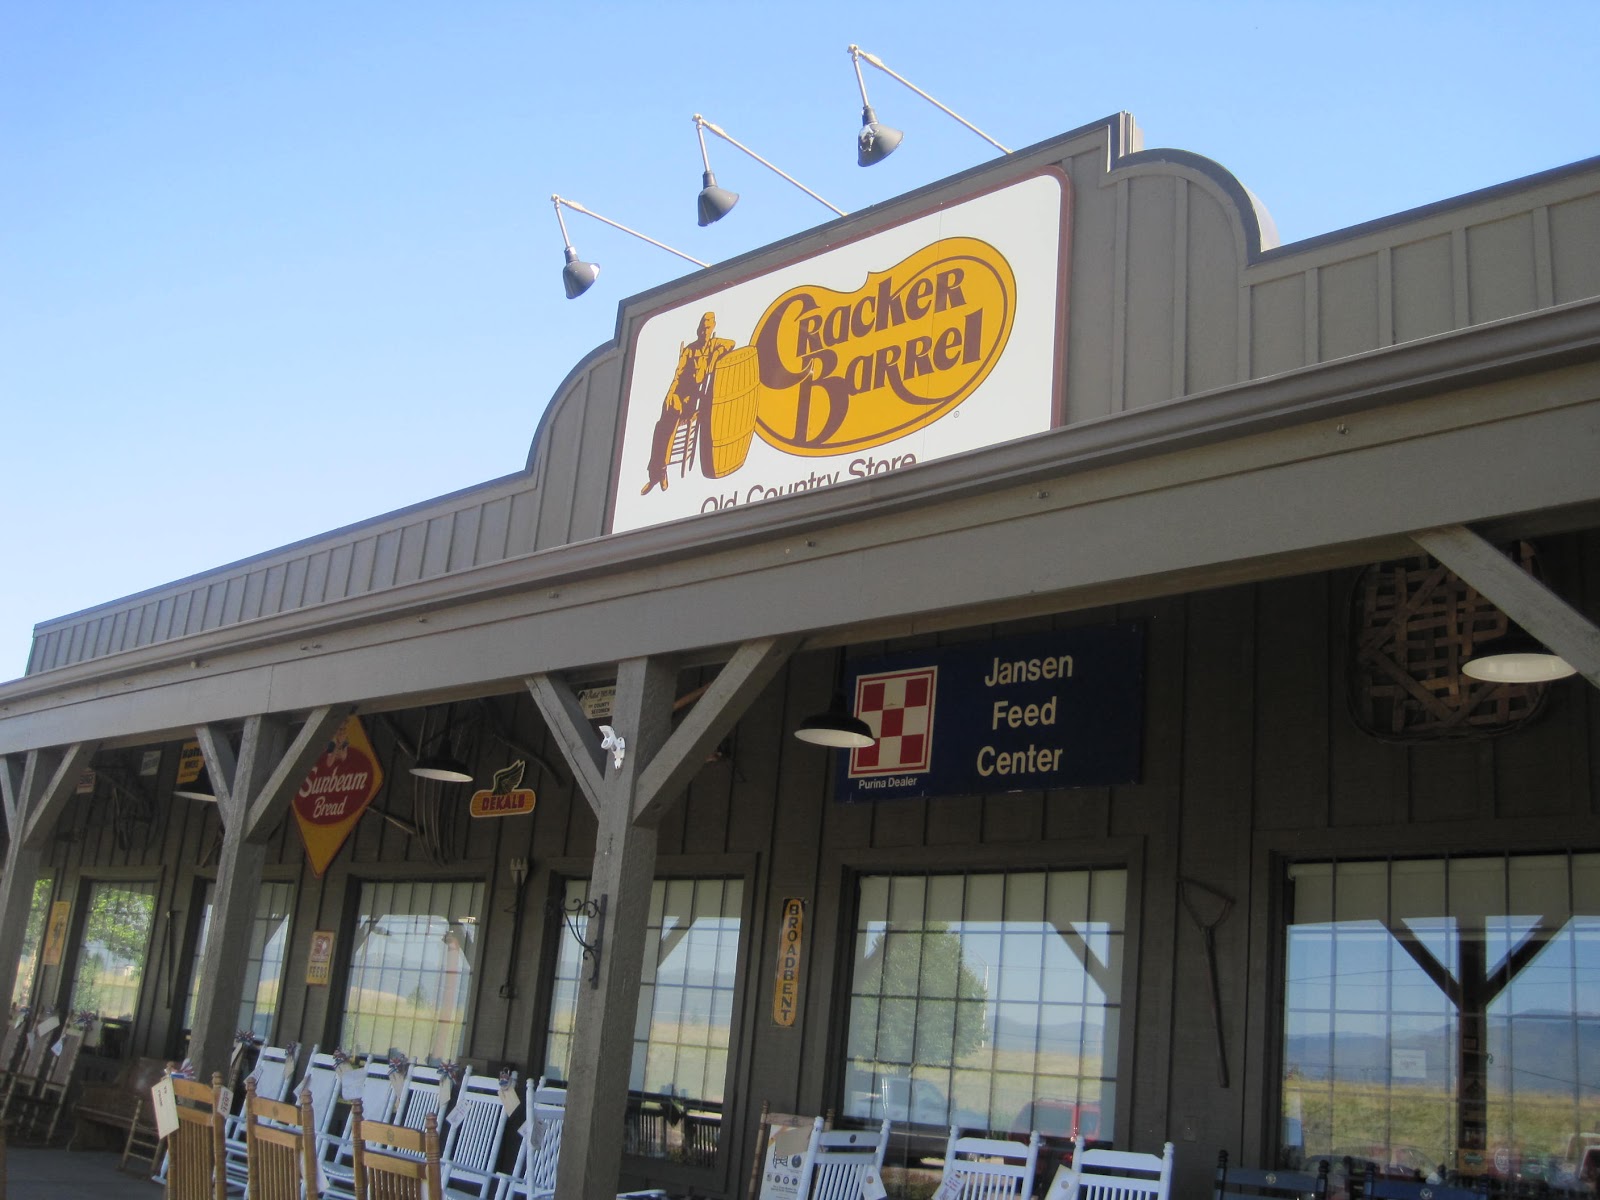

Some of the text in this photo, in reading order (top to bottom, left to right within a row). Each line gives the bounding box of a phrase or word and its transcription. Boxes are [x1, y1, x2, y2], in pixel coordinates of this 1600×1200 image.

[700, 453, 917, 514] Old Country Store
[984, 654, 1073, 687] Jansen
[992, 696, 1057, 730] Feed
[976, 744, 1063, 777] Center
[299, 765, 368, 798] Sunbeam
[858, 776, 918, 790] Purina Dealer
[312, 794, 348, 819] Bread
[781, 903, 800, 1021] BROADBENT
